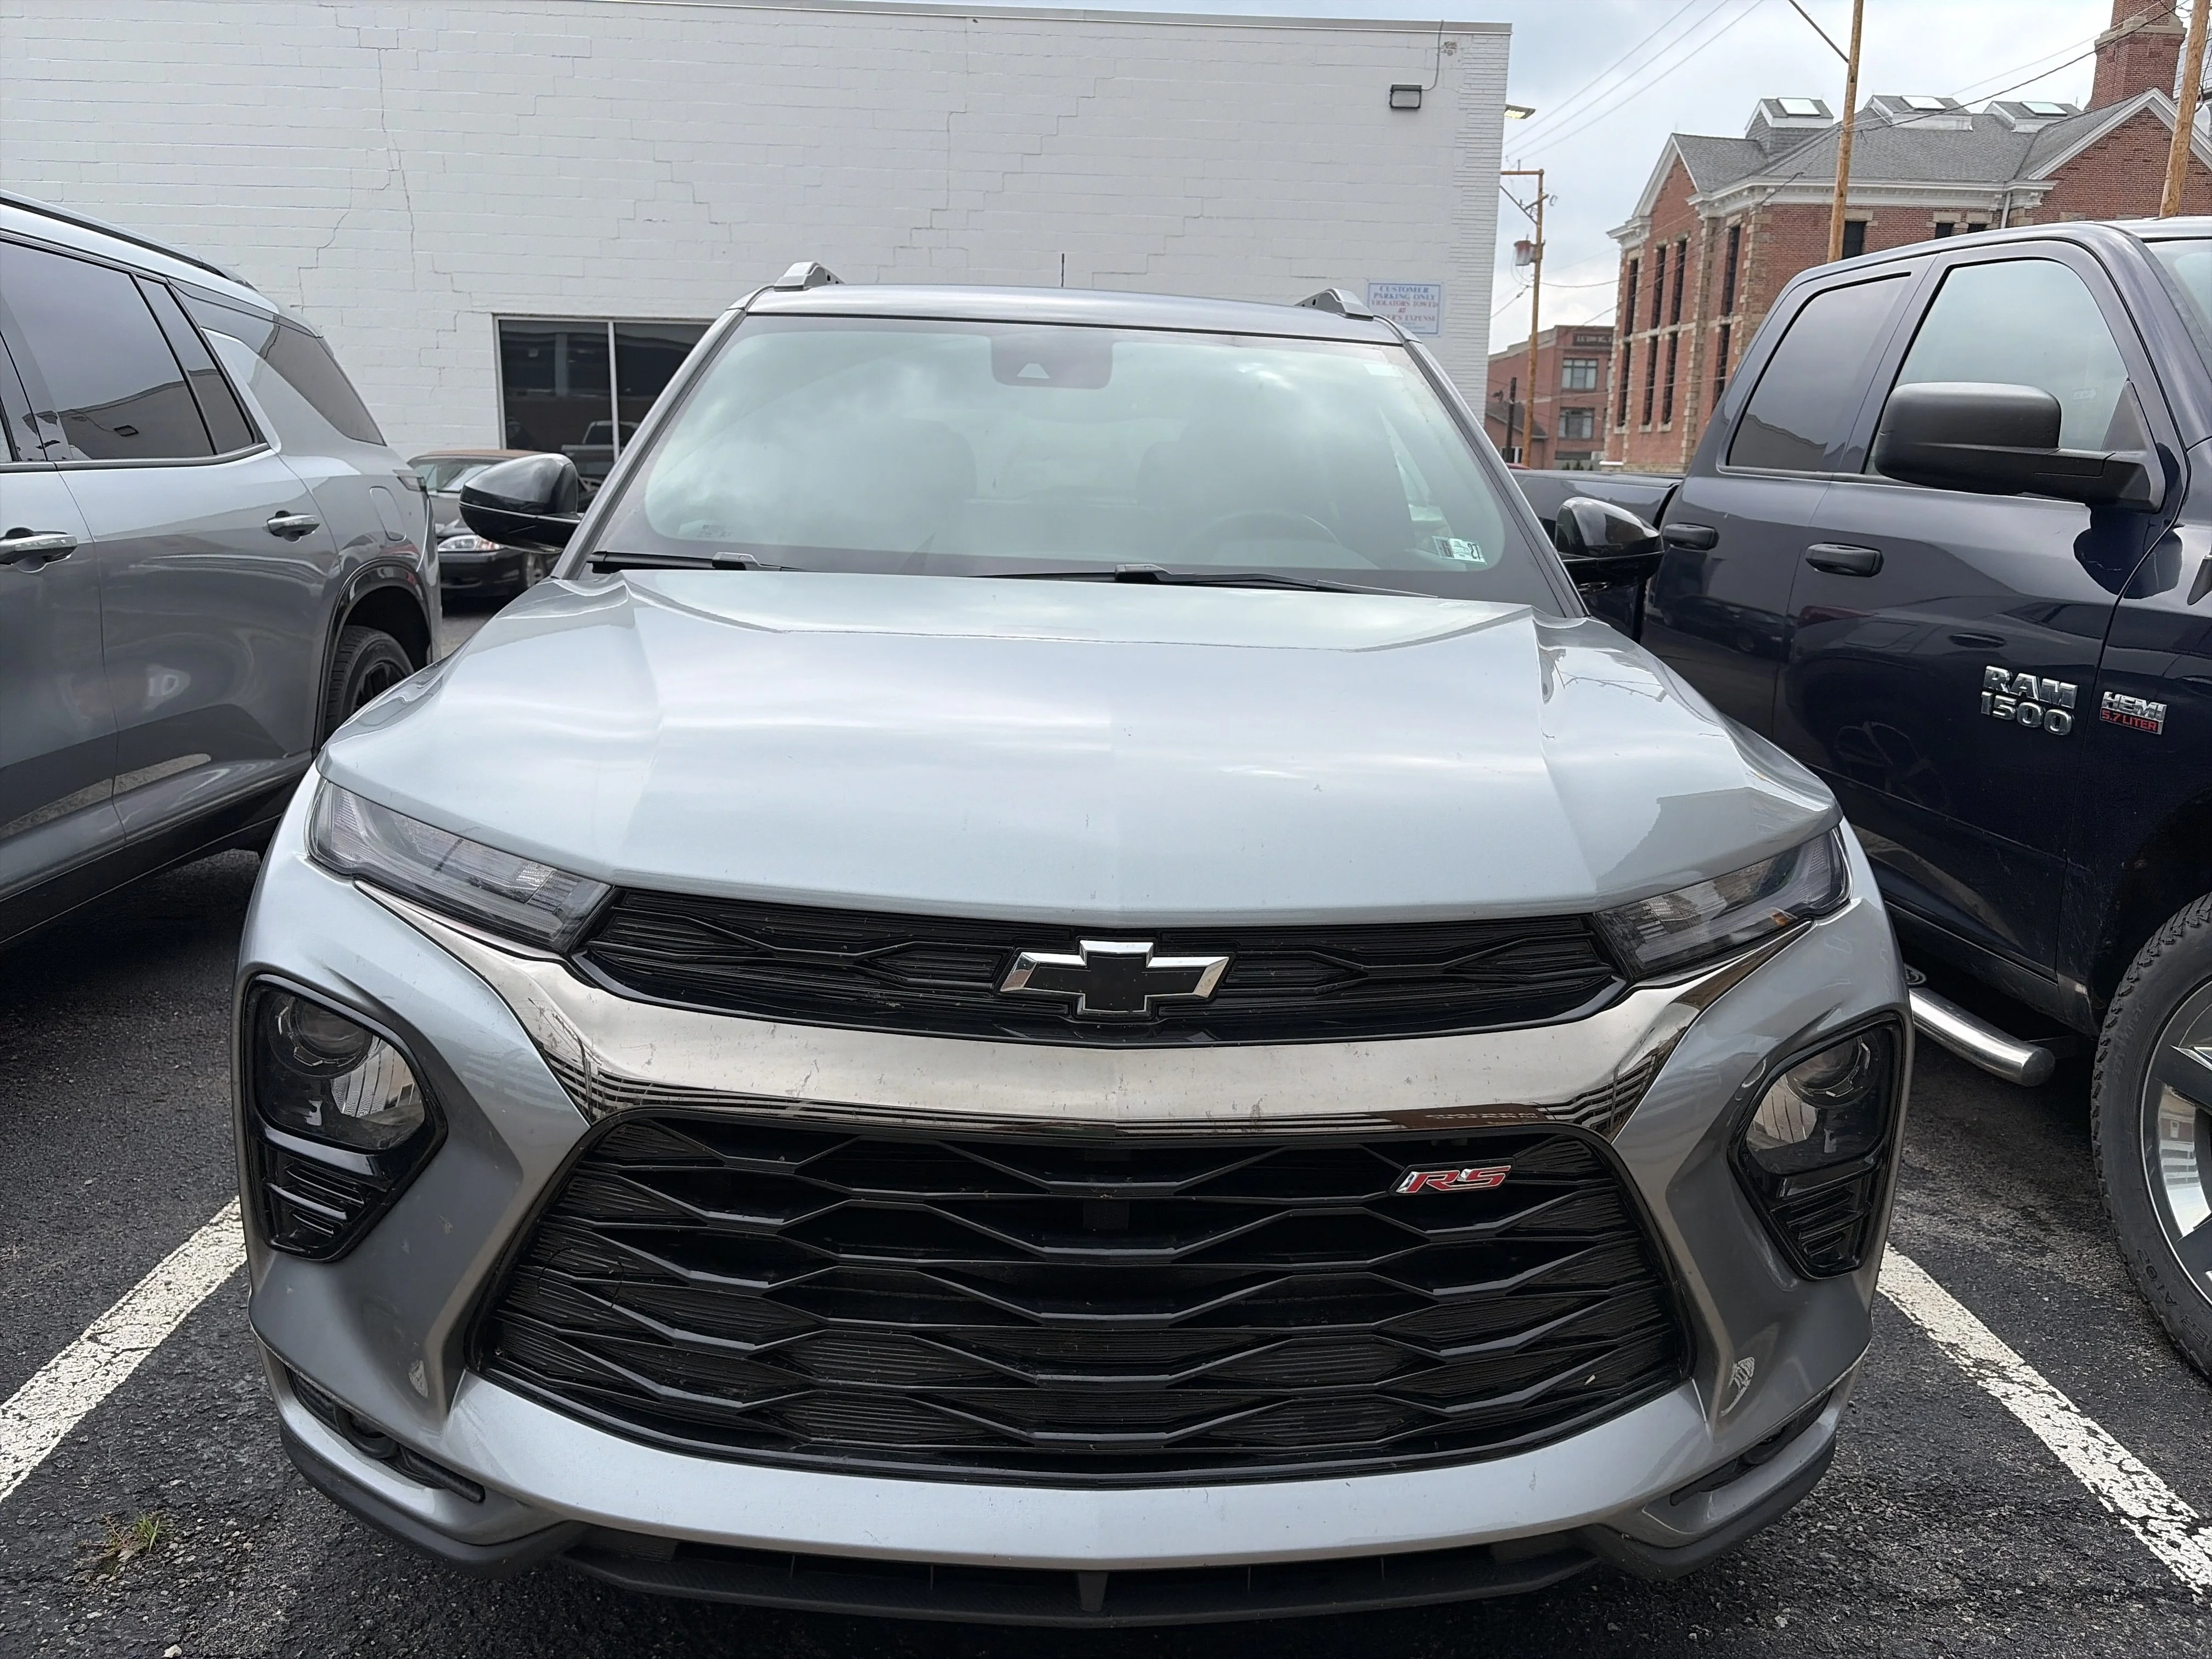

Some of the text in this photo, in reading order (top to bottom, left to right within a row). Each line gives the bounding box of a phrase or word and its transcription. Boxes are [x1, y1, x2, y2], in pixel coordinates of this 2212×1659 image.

[1467, 543, 1481, 561] 27
[1983, 665, 2078, 709] RAM
[1981, 691, 2075, 736] 1500
[2101, 691, 2168, 721] HEMI
[2101, 710, 2158, 732] 5.7 LITER
[1396, 1165, 1511, 1193] RS
